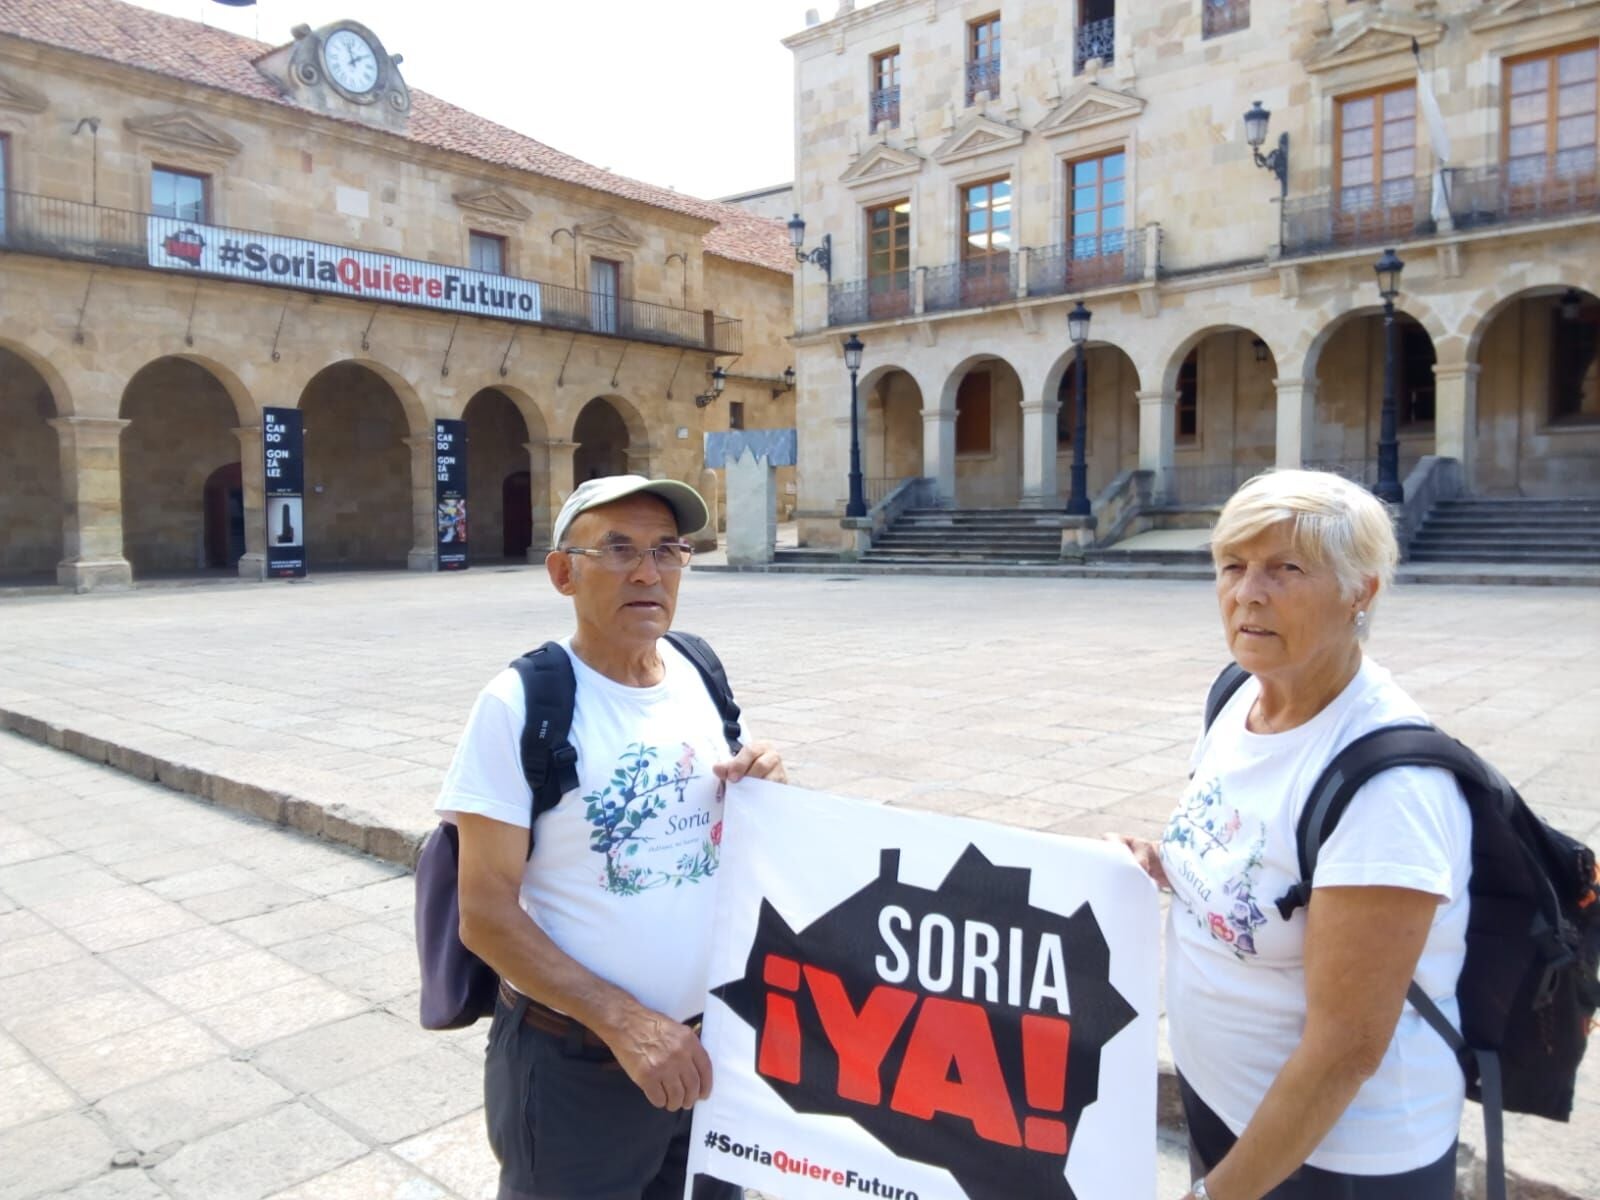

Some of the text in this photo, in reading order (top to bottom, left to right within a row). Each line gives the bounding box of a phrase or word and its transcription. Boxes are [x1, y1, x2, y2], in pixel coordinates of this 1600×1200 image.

[218, 238, 533, 313] #SoriaQuiereFuturo
[266, 424, 286, 433] CAR
[266, 434, 281, 443] DO
[266, 449, 289, 458] GON
[437, 442, 449, 451] DO
[437, 456, 456, 465] GON
[665, 808, 709, 836] Soria
[1178, 860, 1212, 902] Soria
[875, 904, 1071, 1016] SORIA
[758, 953, 1071, 1156] ¡YA!
[704, 1130, 919, 1200] #SoriaQuiereFuturo
